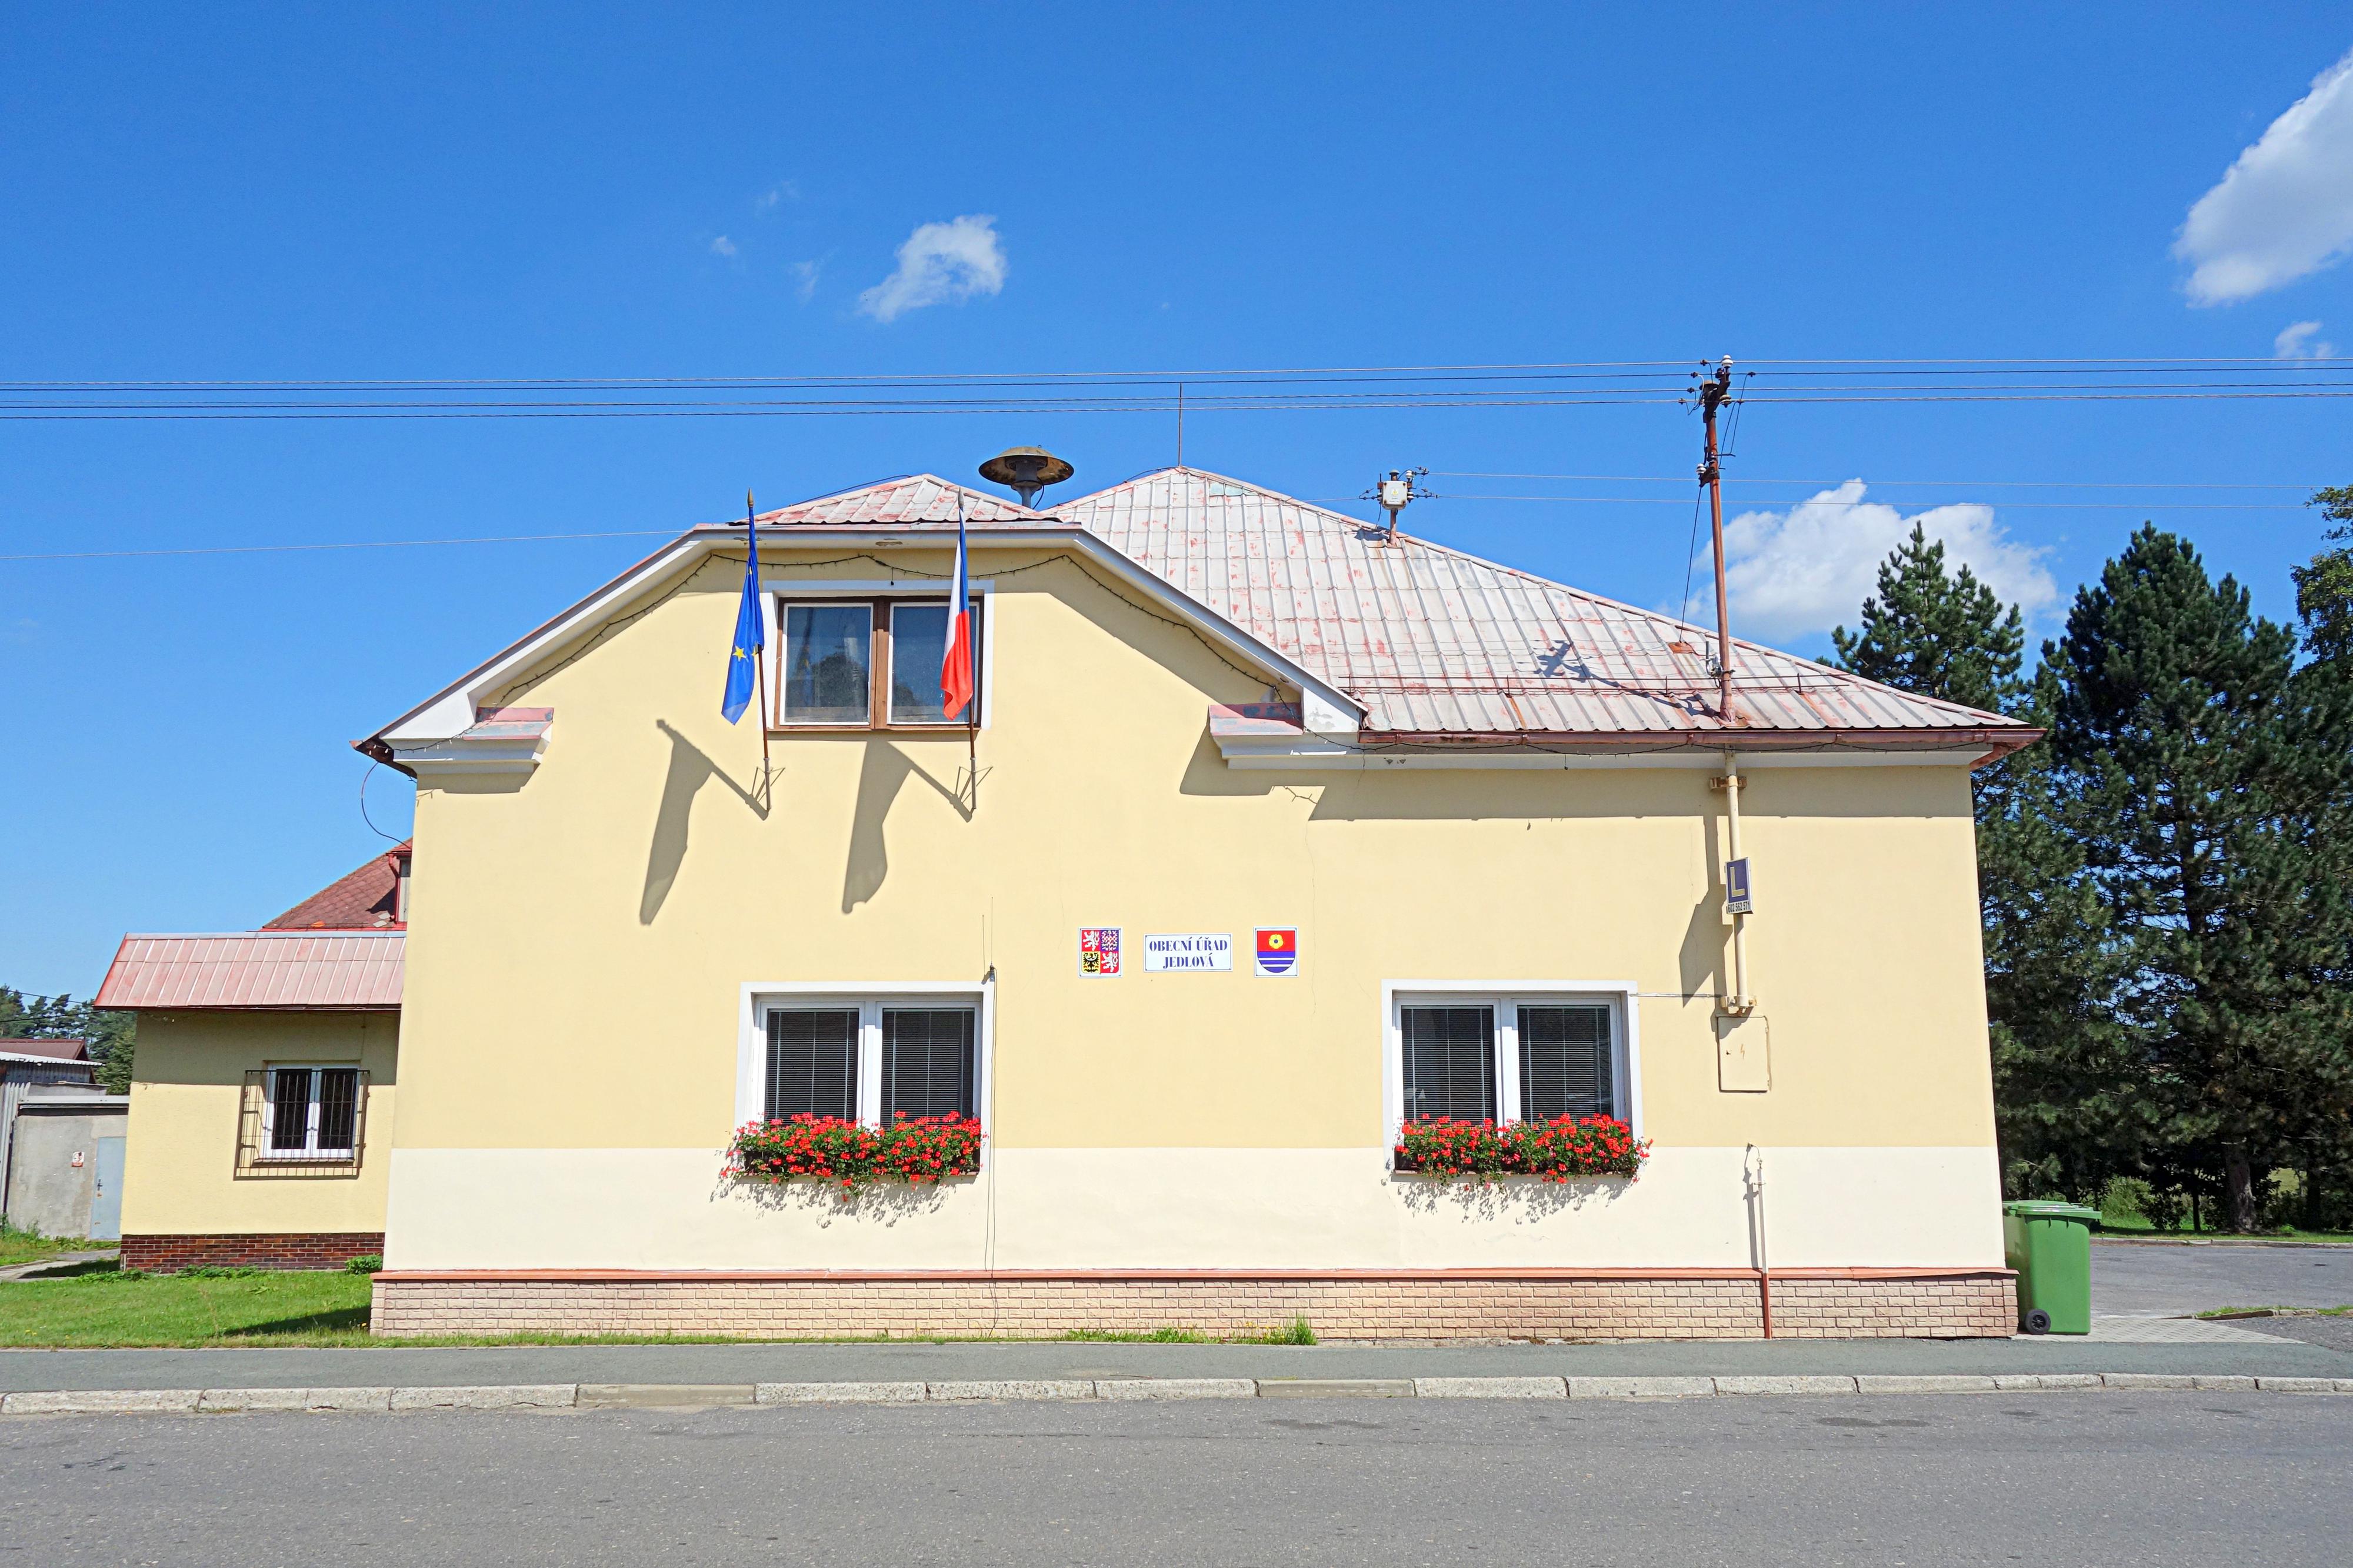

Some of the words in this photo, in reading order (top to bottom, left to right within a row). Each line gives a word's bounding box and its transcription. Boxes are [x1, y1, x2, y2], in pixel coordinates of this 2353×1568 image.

[1730, 866, 1745, 898] L
[1149, 936, 1192, 952] OBECNÍ
[1197, 936, 1228, 951] ÚŘAD
[1163, 952, 1214, 969] JEDLOVÁ
